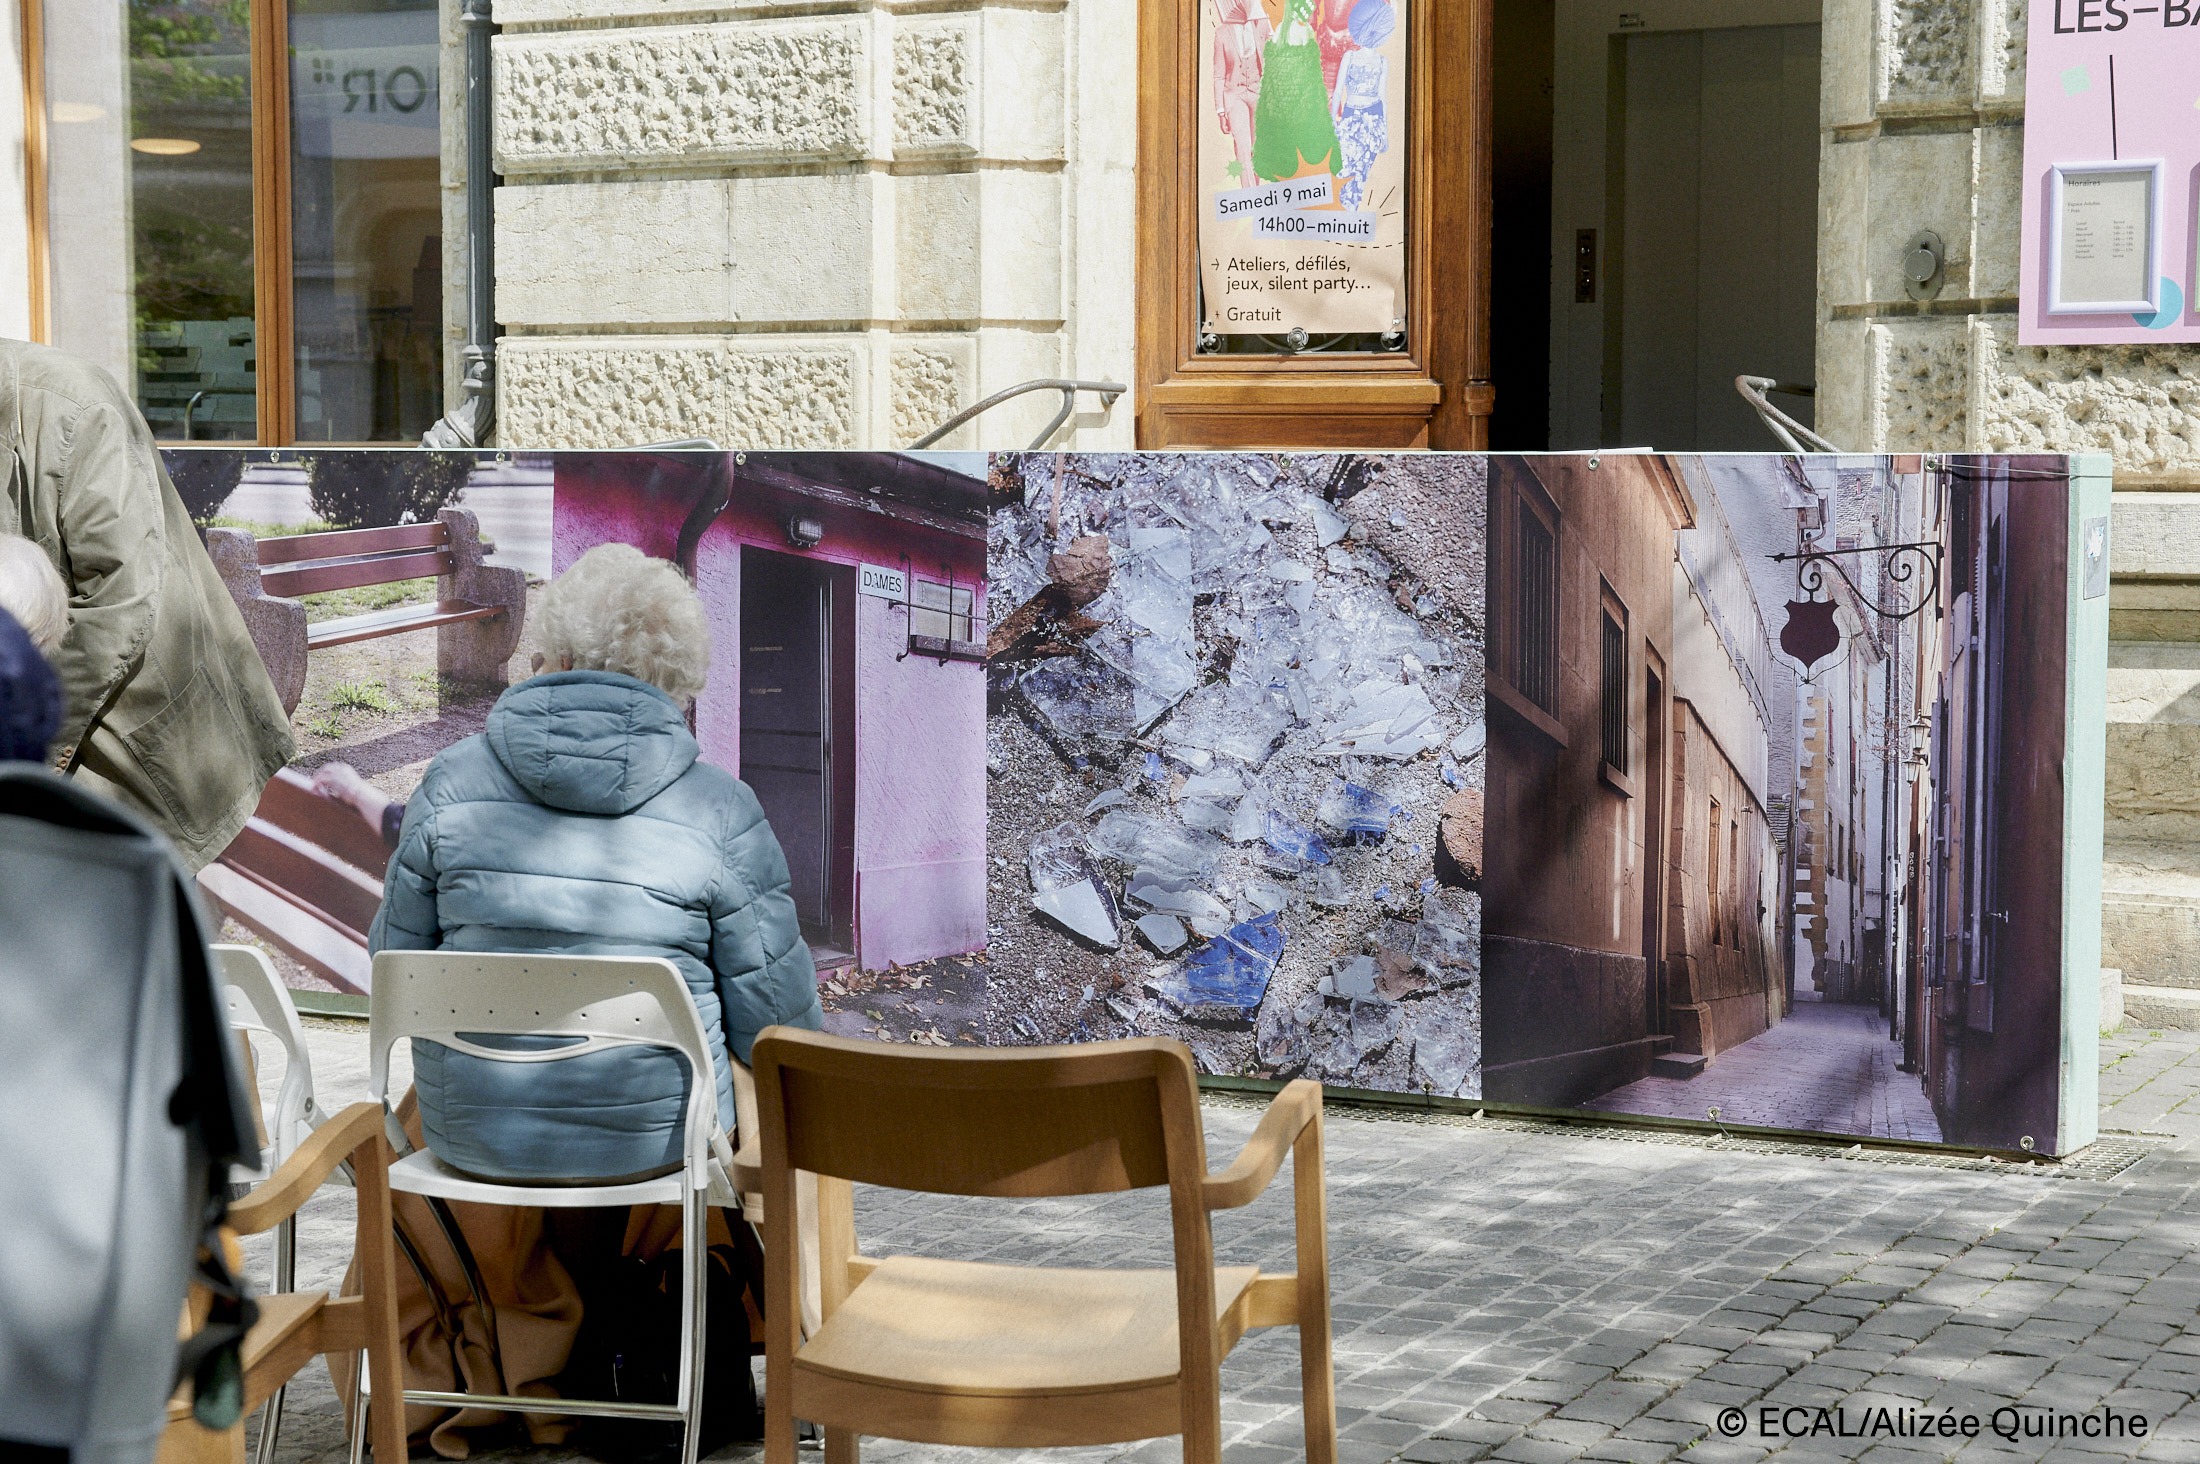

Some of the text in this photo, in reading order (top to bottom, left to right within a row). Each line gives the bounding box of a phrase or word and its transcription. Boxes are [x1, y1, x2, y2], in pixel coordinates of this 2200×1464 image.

[2068, 179, 2101, 188] Horaires
[1219, 182, 1327, 214] Samedi 9 mai
[1227, 255, 1351, 273] Ateliers, défilés,
[1226, 275, 1372, 295] jeux, silent party...
[1226, 306, 1282, 321] Gratuit
[863, 570, 902, 593] DAMES
